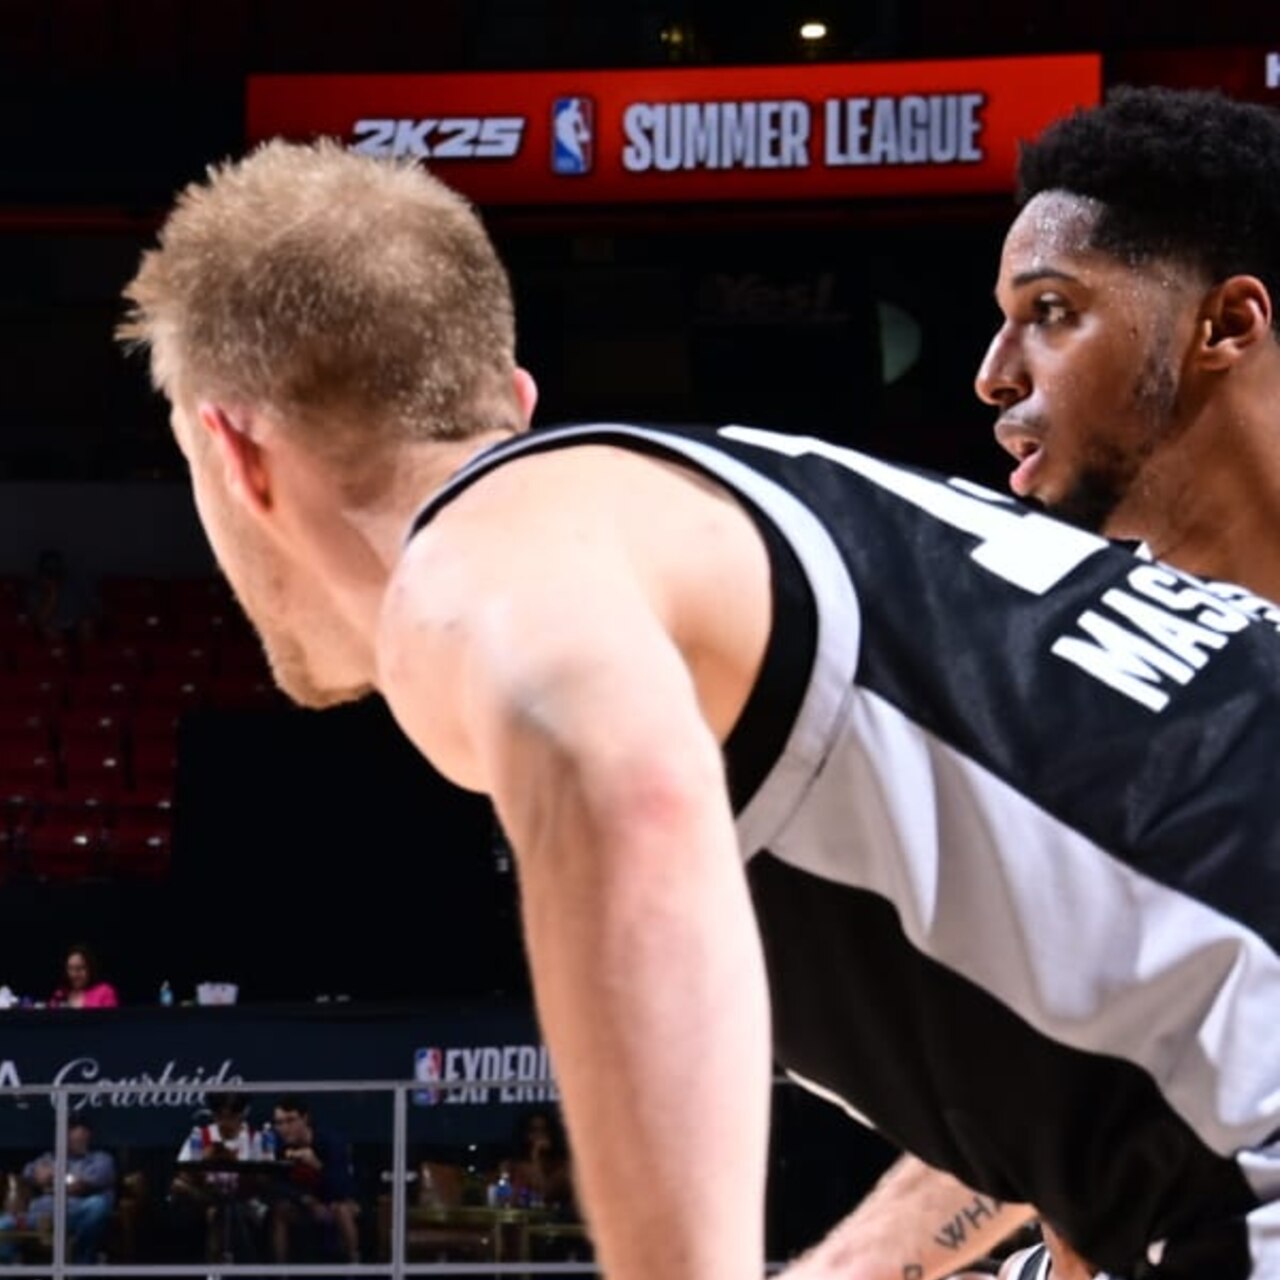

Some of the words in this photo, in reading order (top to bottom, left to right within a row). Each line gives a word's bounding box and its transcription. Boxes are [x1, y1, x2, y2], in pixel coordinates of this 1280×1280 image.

[351, 117, 523, 158] 2K25
[622, 102, 809, 172] SUMMER
[825, 94, 984, 167] LEAGUE
